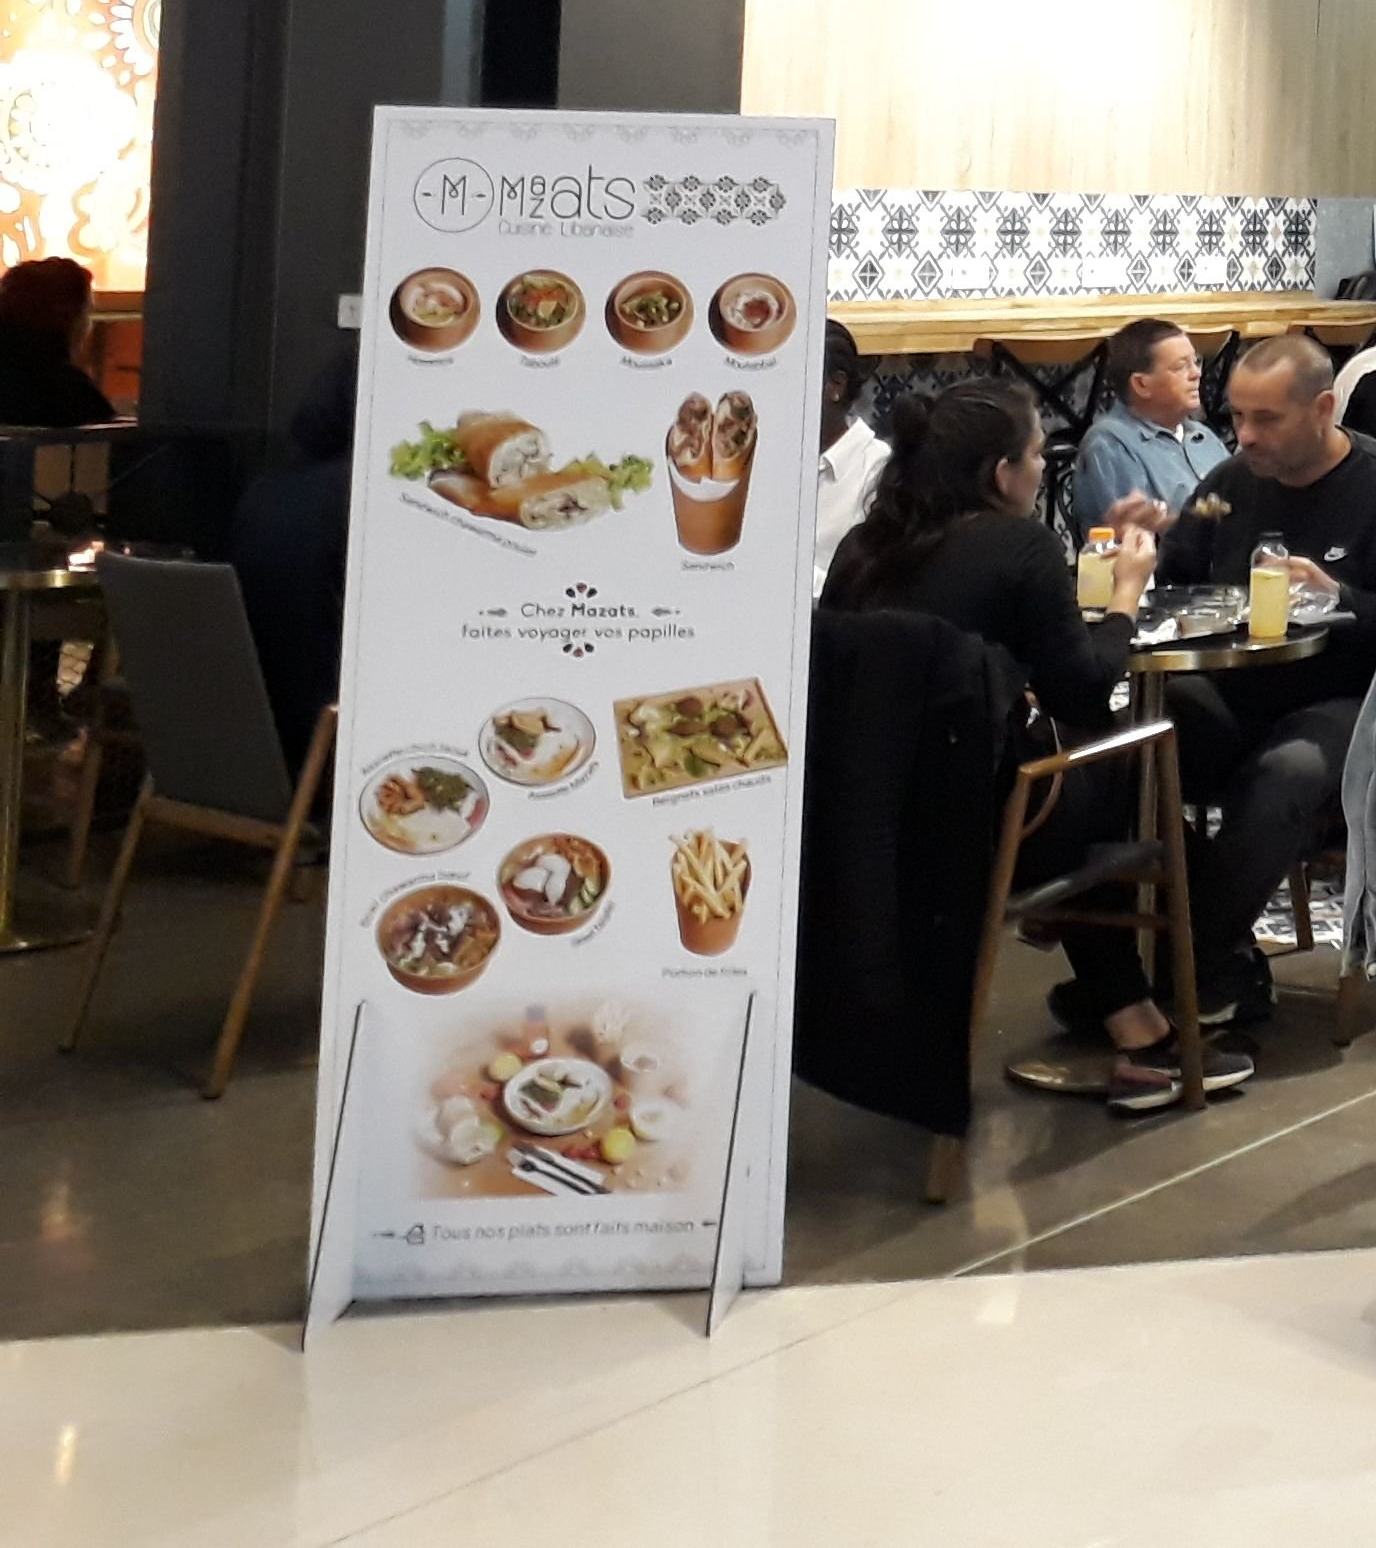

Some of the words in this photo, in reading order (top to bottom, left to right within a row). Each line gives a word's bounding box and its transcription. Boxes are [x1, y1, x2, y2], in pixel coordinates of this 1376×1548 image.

[520, 603, 565, 618] Chez
[462, 623, 512, 639] faites
[517, 627, 587, 642] voyager
[594, 627, 623, 639] vos
[628, 623, 695, 642] papilles
